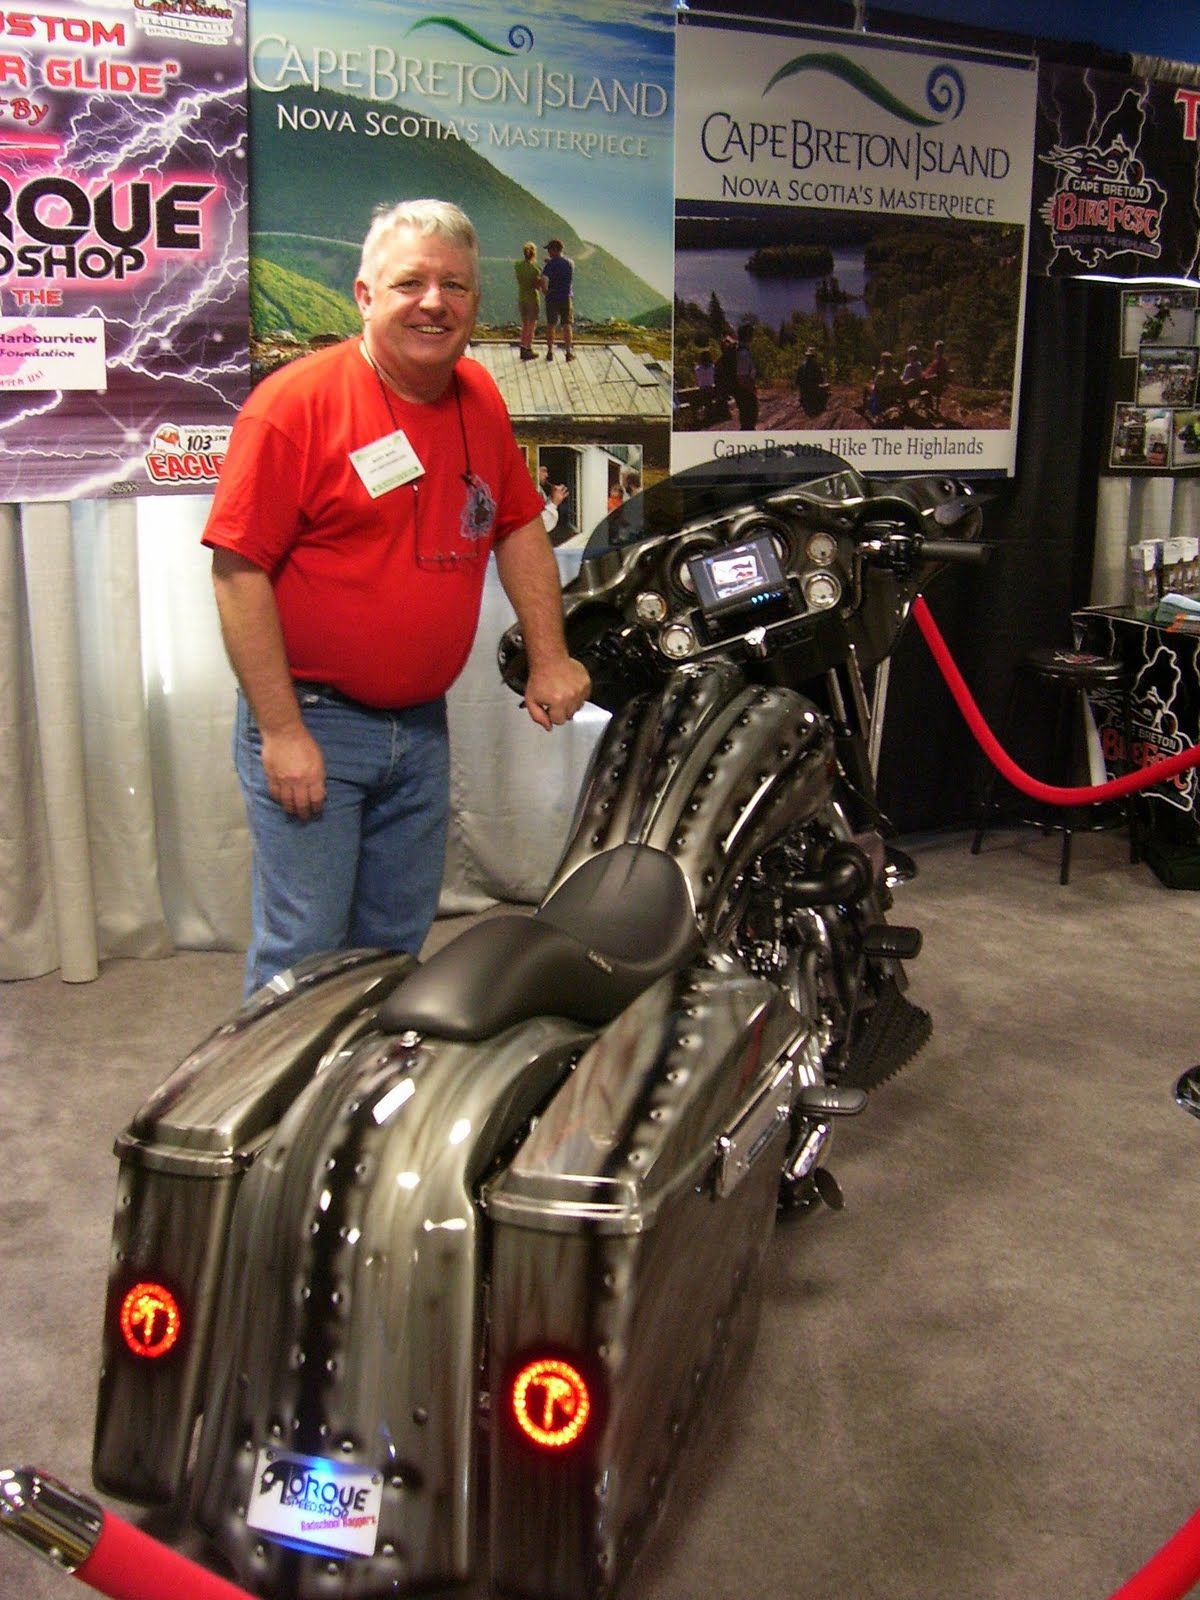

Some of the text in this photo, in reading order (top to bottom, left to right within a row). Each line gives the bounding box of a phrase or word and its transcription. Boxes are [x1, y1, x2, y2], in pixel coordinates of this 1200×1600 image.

[0, 11, 125, 46] STOM
[249, 33, 670, 119] CAPE BRETON ISLAND
[10, 97, 49, 126] By
[277, 104, 649, 160] NOVA SCOTIA'S MASTERPIECE
[701, 112, 1010, 181] CAPE BRETON ISLAND
[722, 175, 995, 219] NOVA SCOTIA'S MASTERPIECE
[1072, 180, 1144, 198] CAPE BRETON
[0, 176, 217, 249] QUE
[11, 288, 62, 306] THE
[829, 438, 867, 456] Hike
[872, 437, 902, 456] The
[906, 437, 983, 460] Highlands
[1139, 728, 1177, 750] BRETON
[260, 1461, 371, 1511] TORQUE
